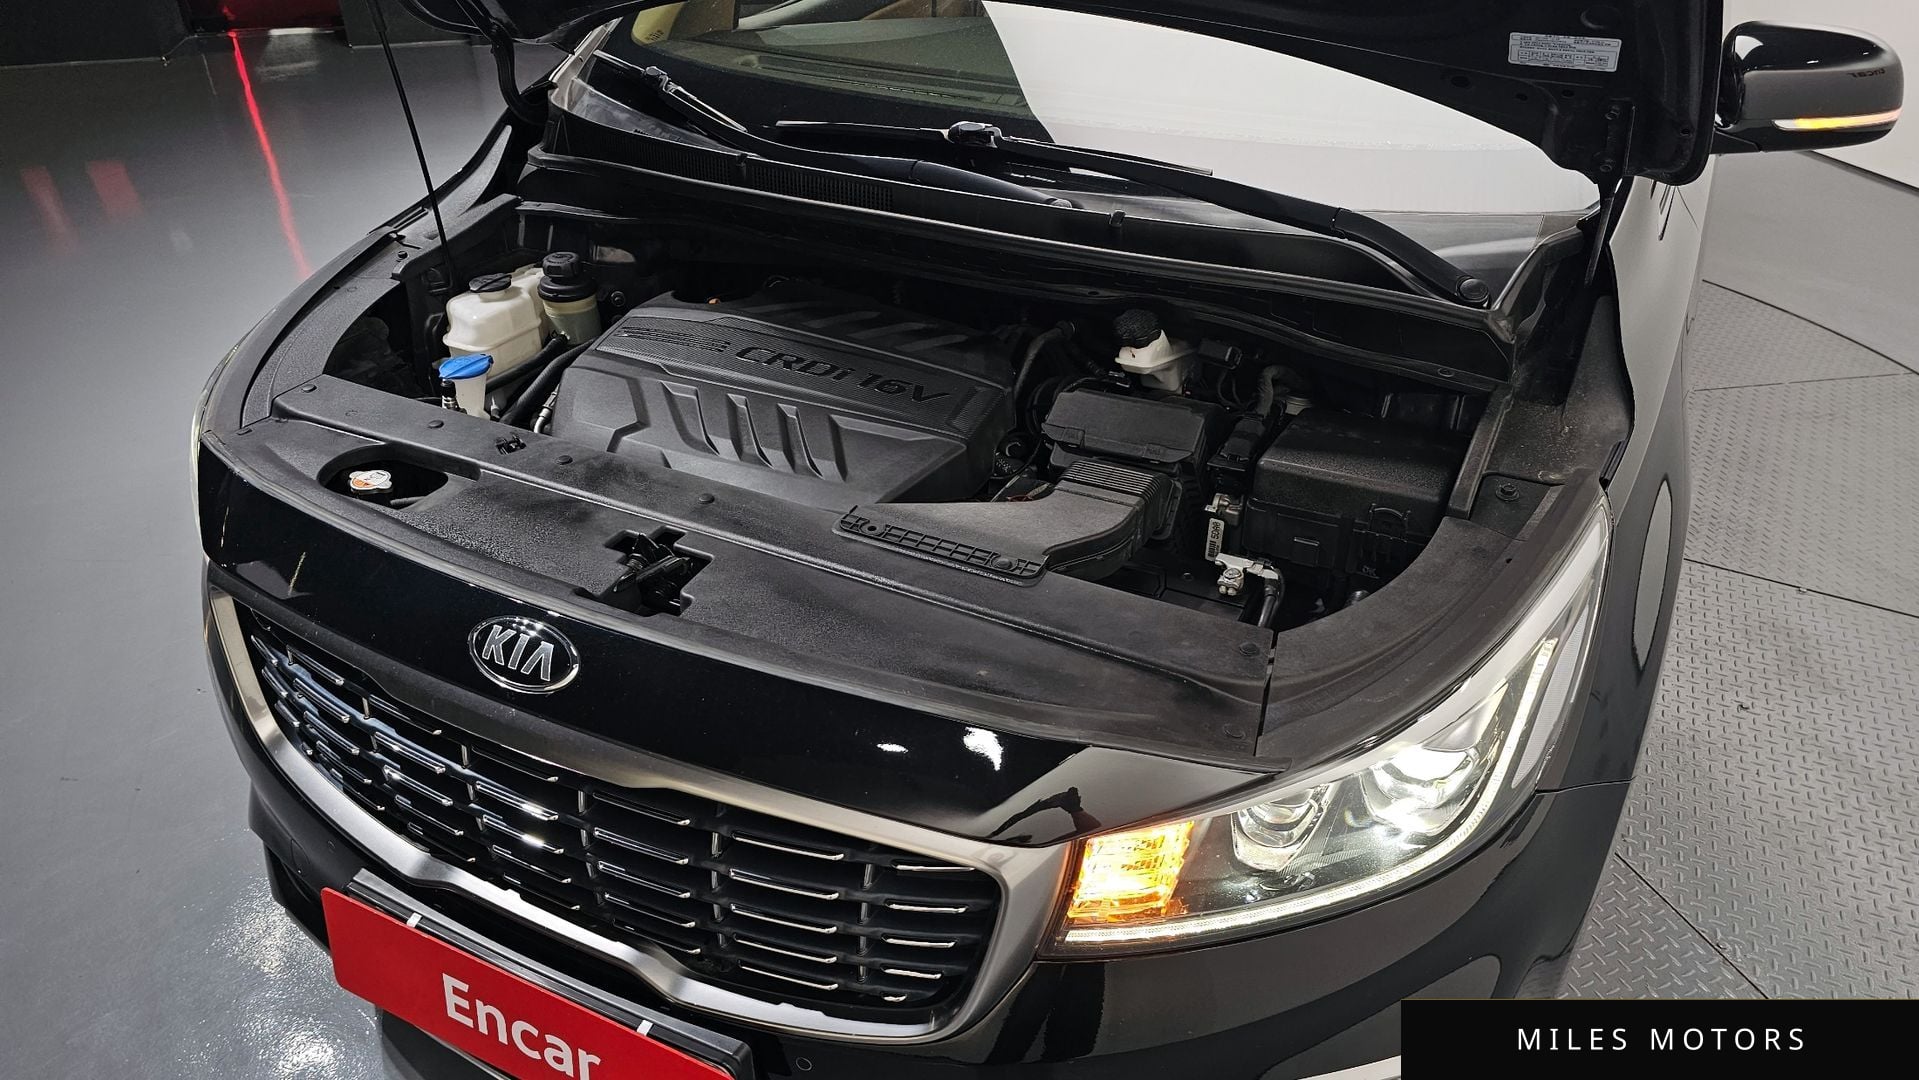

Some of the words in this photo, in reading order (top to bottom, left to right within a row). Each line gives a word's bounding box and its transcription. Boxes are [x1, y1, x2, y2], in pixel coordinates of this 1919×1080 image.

[857, 372, 951, 403] 16V
[481, 624, 555, 682] KIA
[441, 972, 601, 1080] Encar
